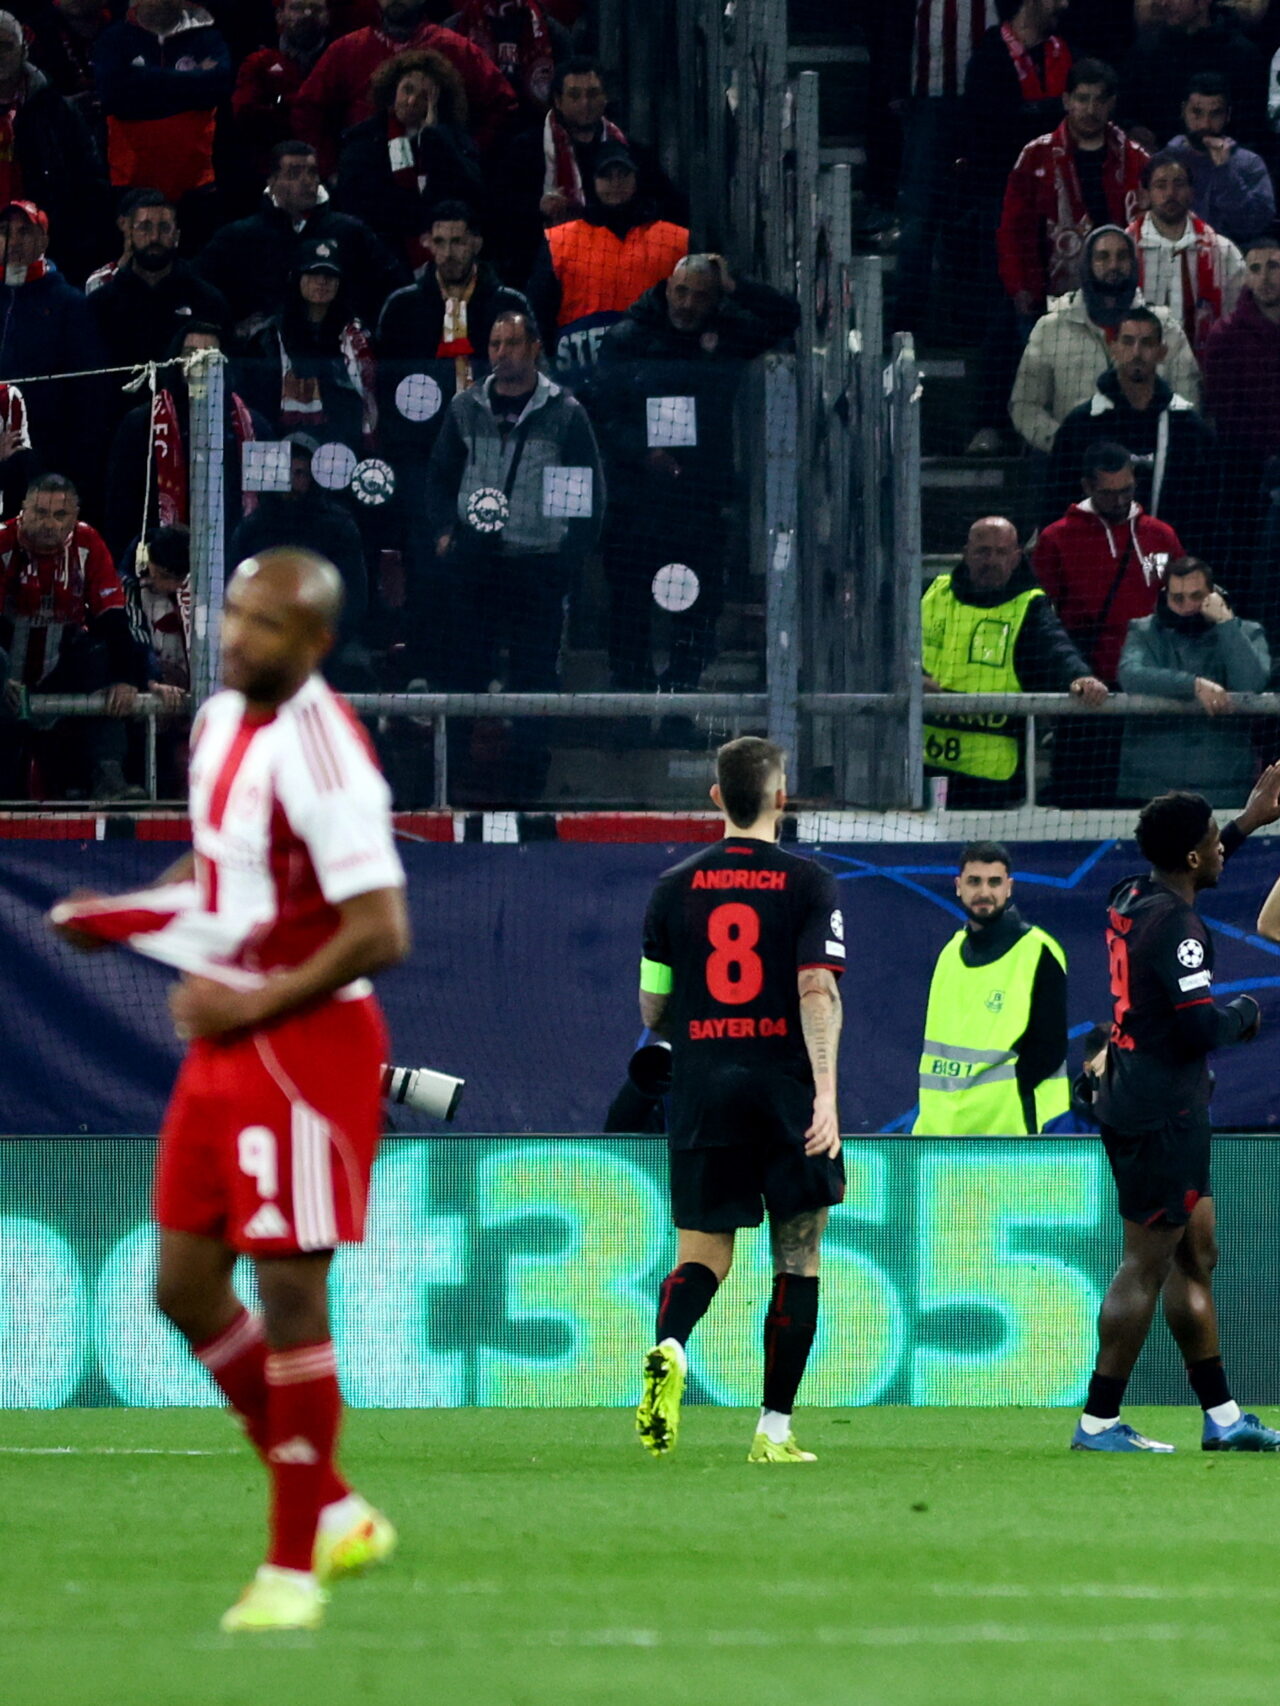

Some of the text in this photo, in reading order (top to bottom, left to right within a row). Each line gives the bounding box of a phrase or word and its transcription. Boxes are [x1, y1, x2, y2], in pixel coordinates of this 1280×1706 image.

[691, 869, 787, 890] ANDRICH
[706, 902, 764, 1005] 8
[689, 1017, 788, 1040] BAYER 04
[237, 1126, 278, 1198] 9
